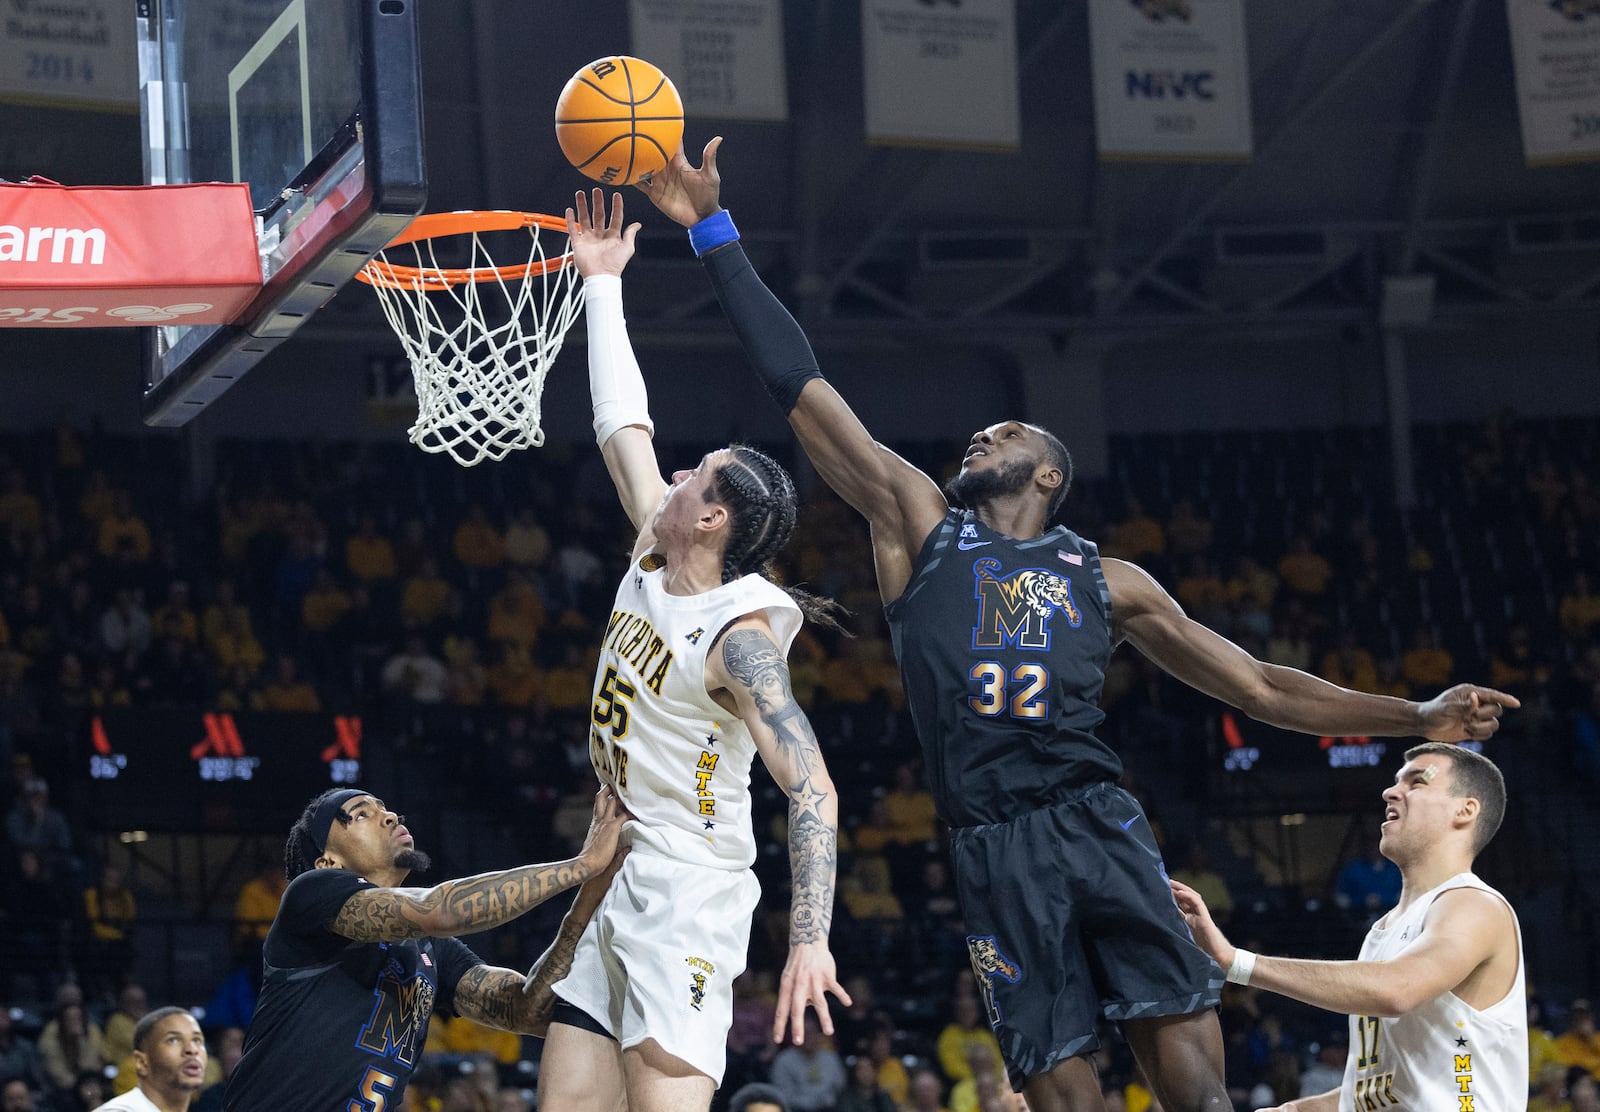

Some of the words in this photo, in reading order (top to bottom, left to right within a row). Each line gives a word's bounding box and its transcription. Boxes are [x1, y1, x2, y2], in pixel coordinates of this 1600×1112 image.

[0, 225, 106, 265] arm
[972, 575, 1051, 651] M
[601, 610, 673, 697] WICHITA
[592, 663, 637, 740] 55
[968, 661, 1050, 720] 32
[355, 970, 416, 1070] M
[1357, 1015, 1379, 1070] 17
[347, 1064, 399, 1112] 5
